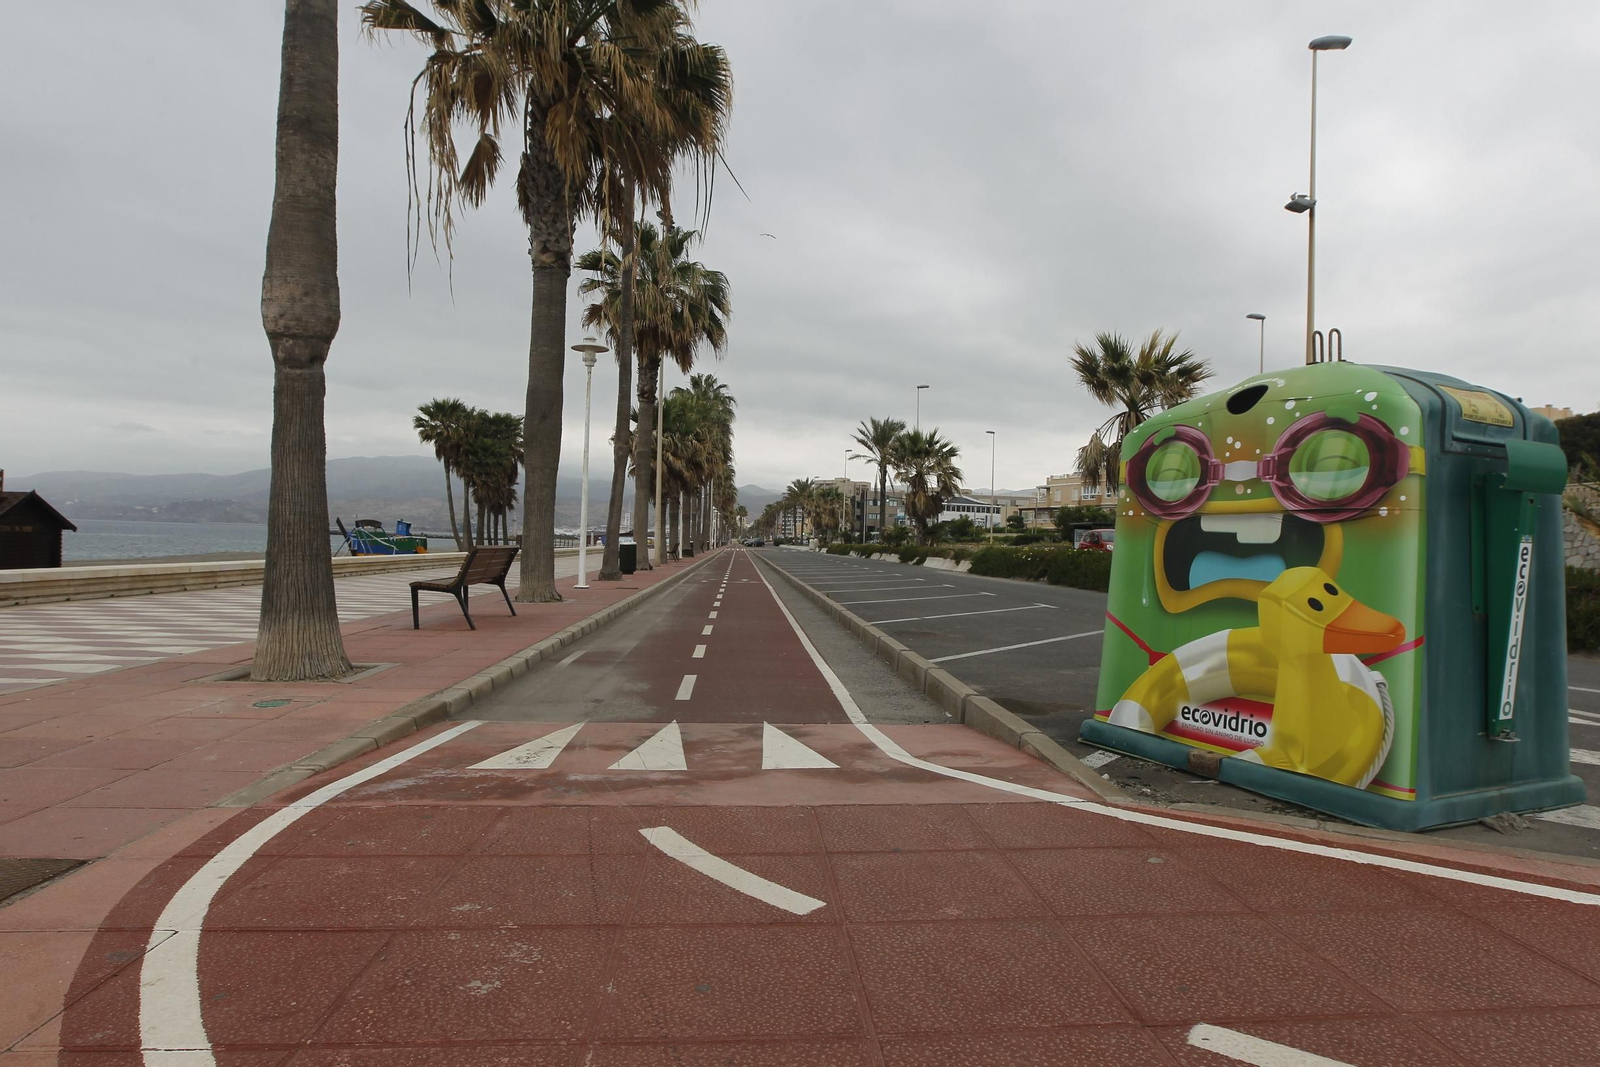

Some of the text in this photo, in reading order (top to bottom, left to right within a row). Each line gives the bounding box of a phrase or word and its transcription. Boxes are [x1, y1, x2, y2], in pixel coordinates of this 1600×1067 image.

[1181, 706, 1267, 737] ecovidrio
[1181, 723, 1204, 733] ENTIDAD
[1243, 737, 1265, 747] LUCRO
